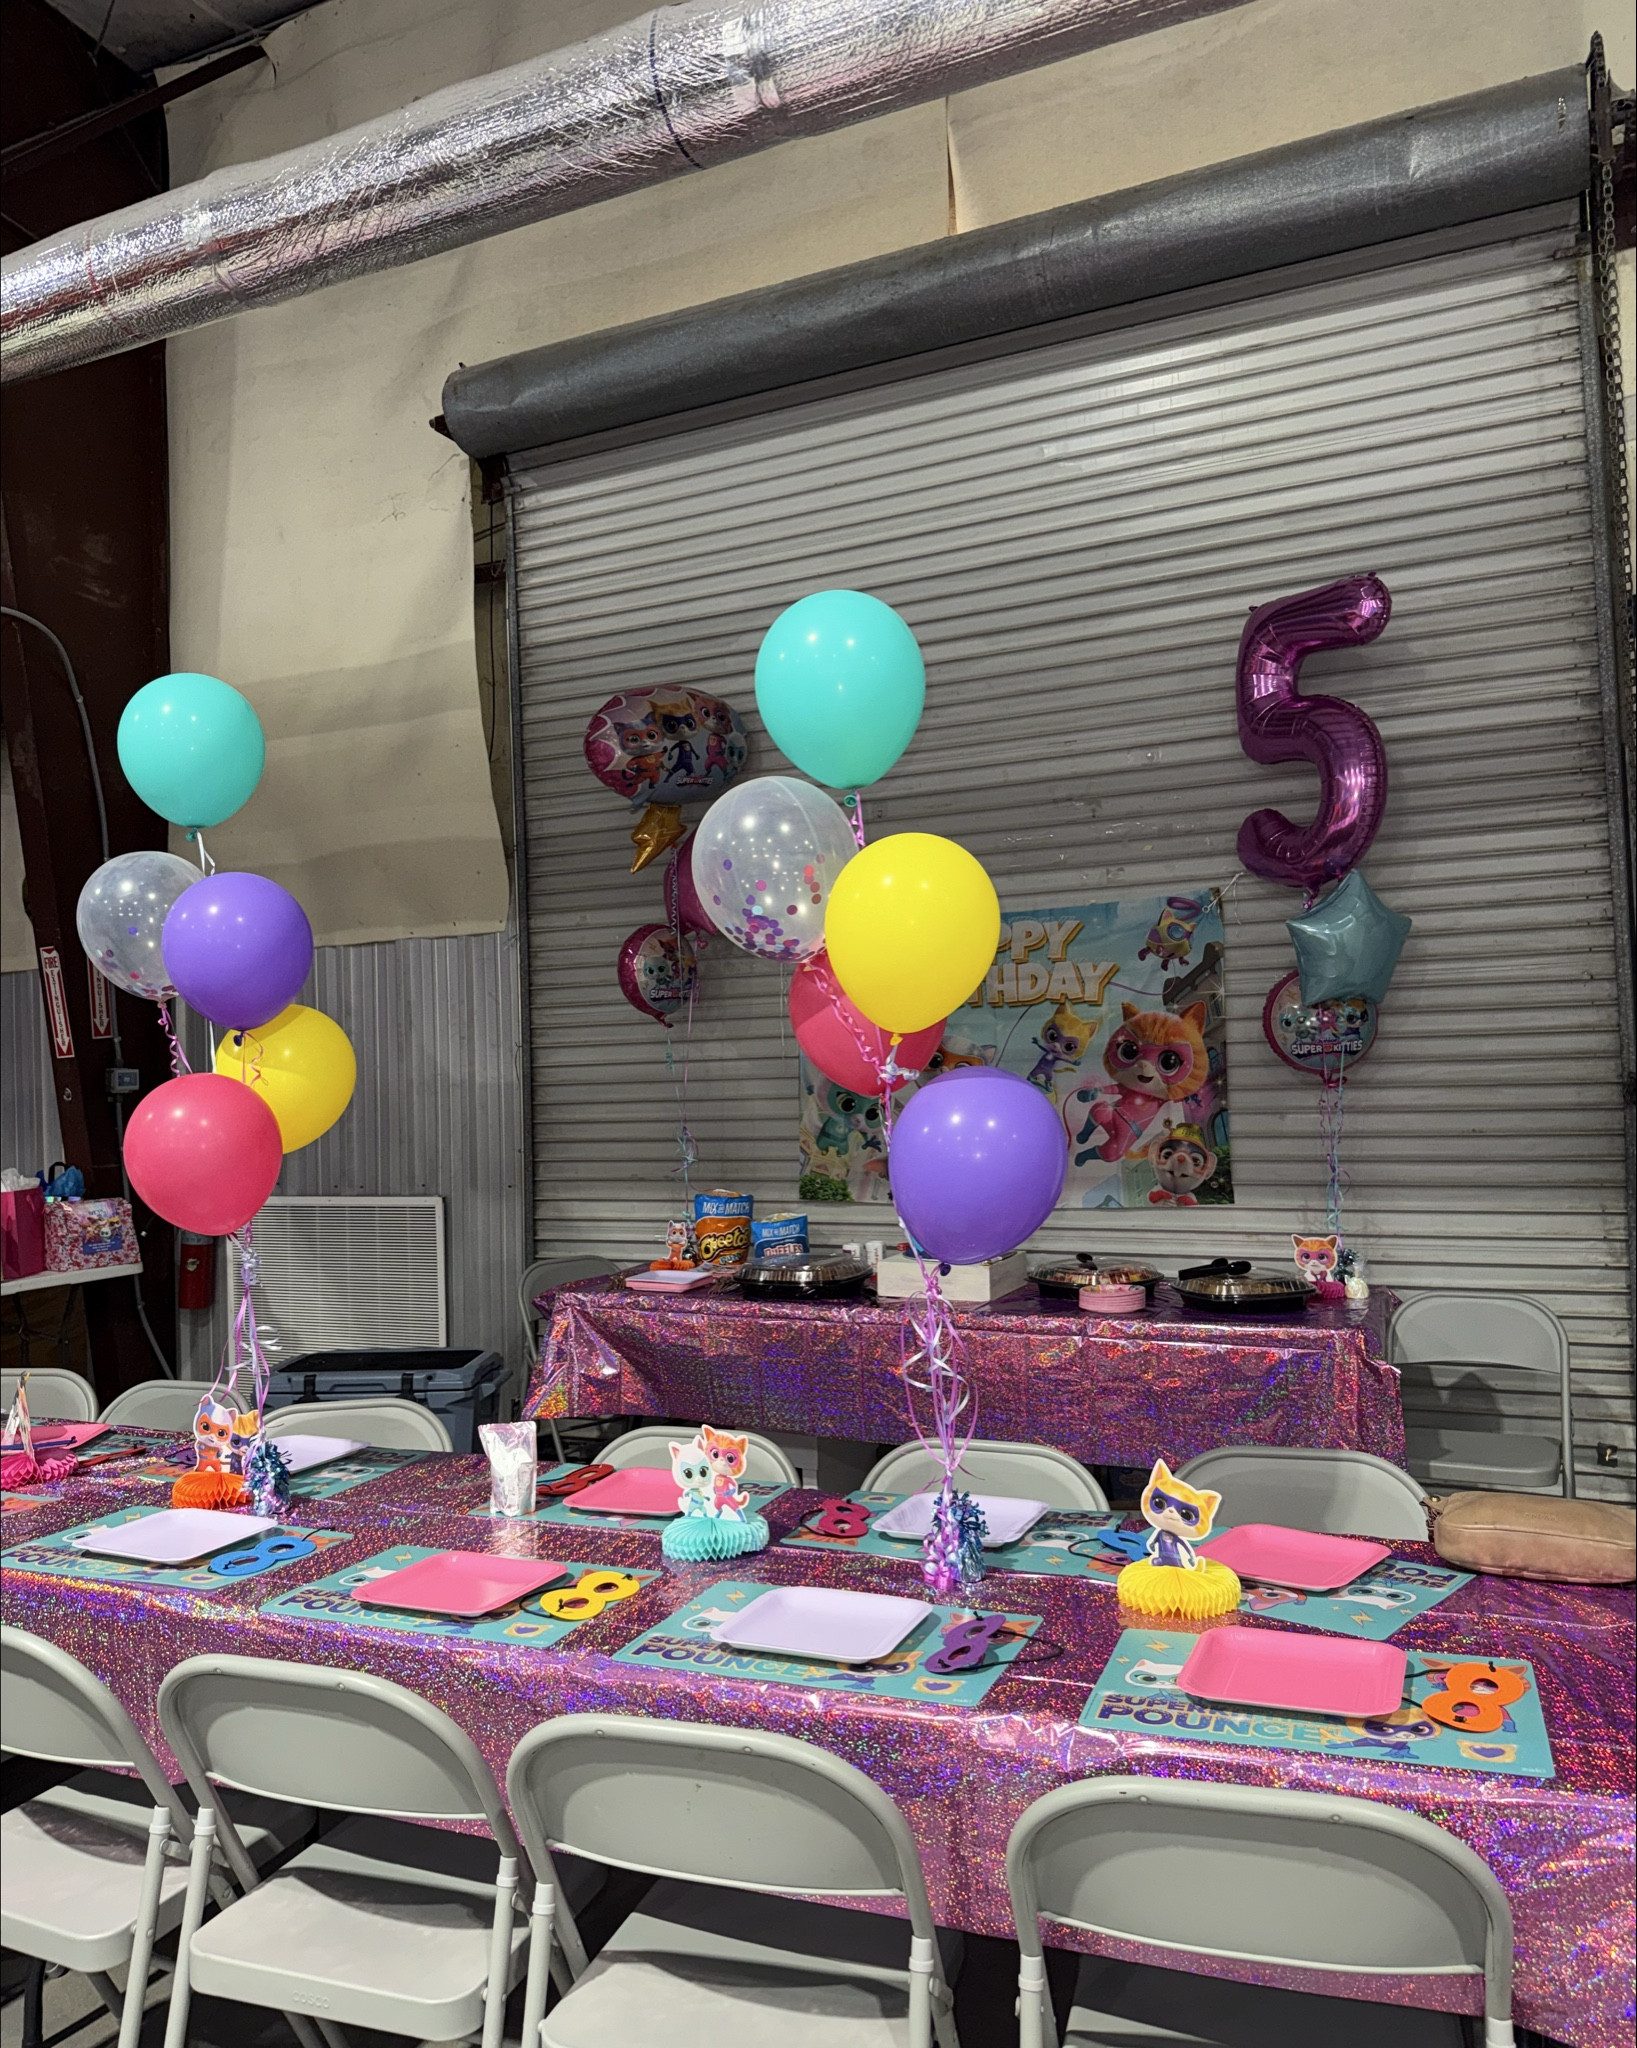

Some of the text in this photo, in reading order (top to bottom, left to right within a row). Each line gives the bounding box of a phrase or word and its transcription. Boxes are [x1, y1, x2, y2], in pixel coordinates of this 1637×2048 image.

[1237, 574, 1392, 888] 5
[44, 956, 58, 969] FIRE
[650, 989, 672, 999] SUPER
[1291, 1040, 1363, 1055] SUPER KITTIES
[702, 1201, 718, 1215] MIX
